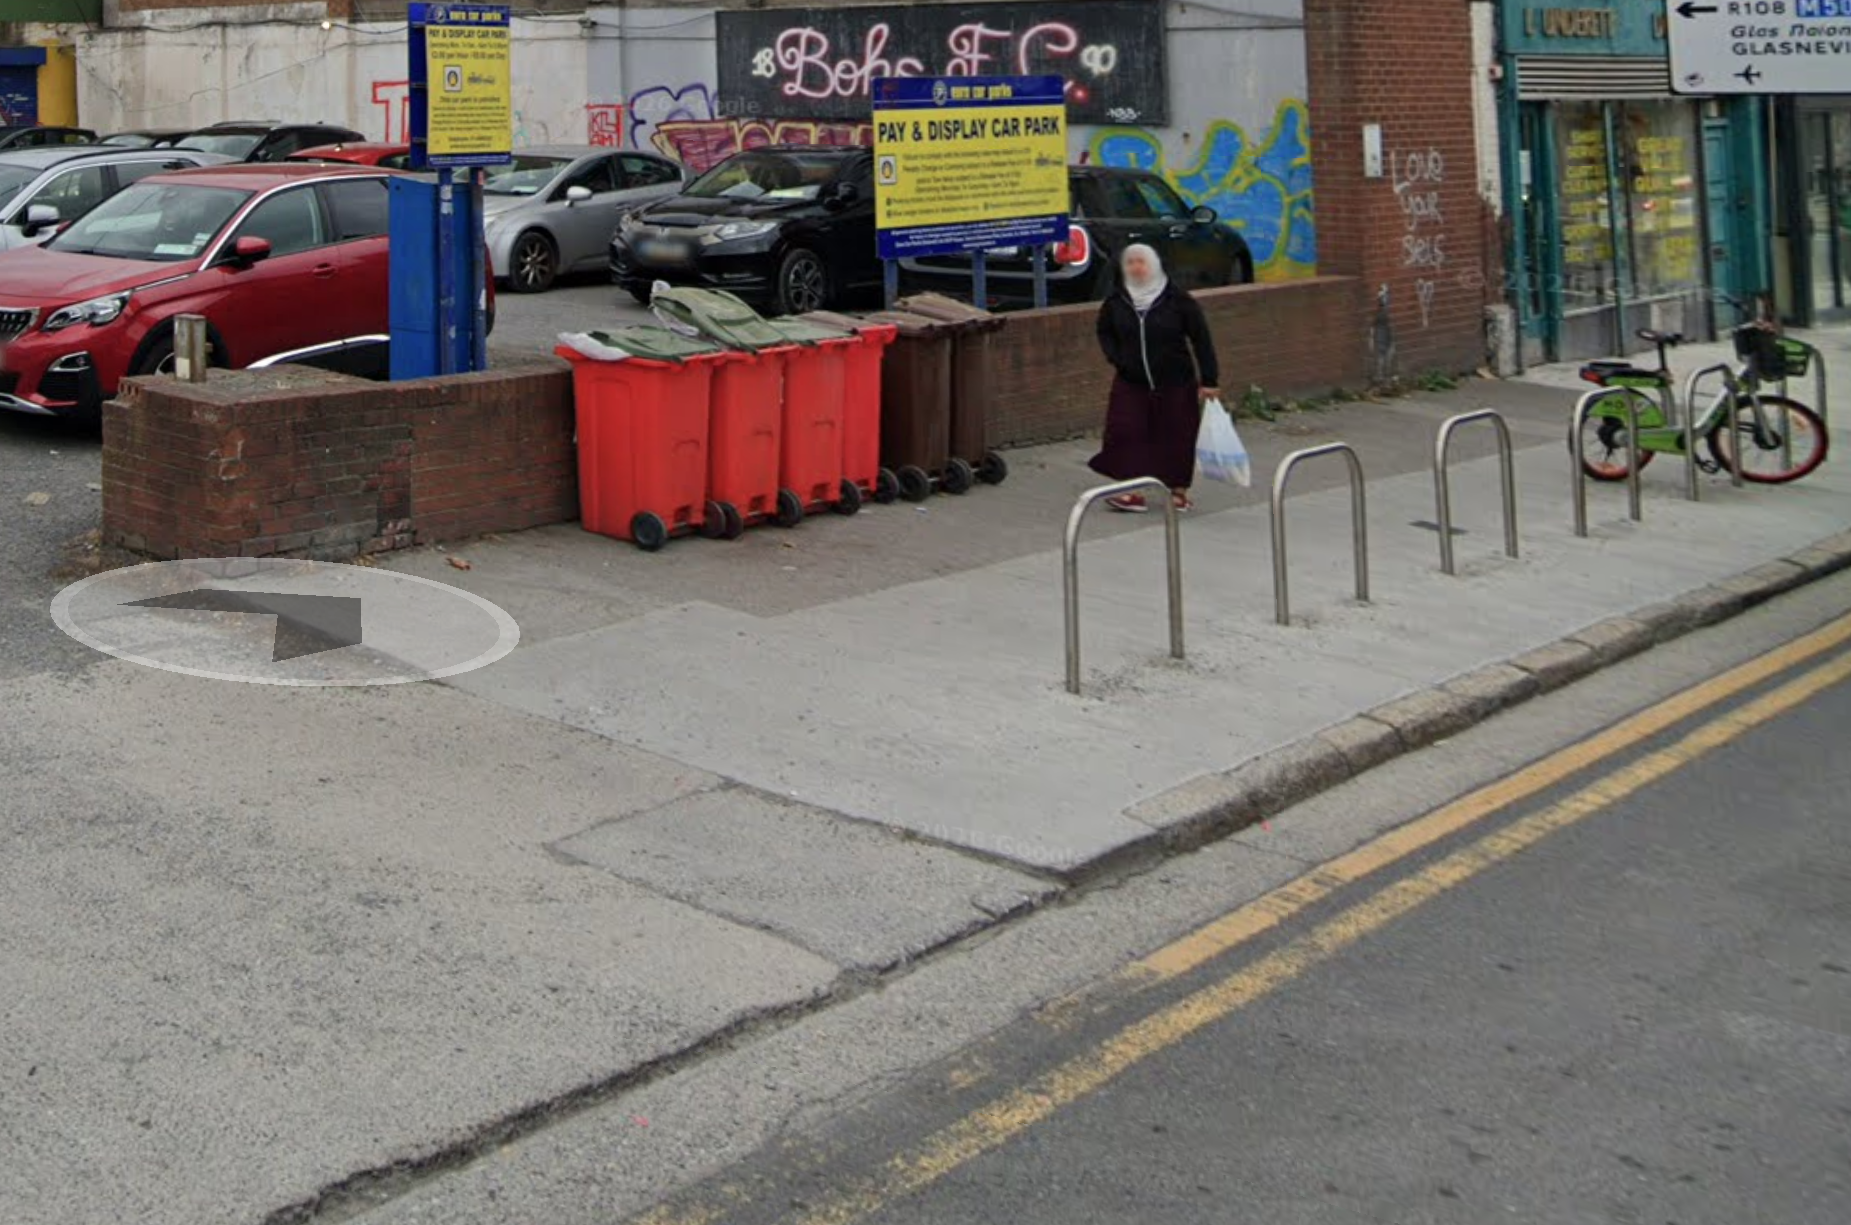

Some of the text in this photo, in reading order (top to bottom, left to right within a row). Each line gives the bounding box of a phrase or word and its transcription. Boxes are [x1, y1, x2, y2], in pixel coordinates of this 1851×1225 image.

[1728, 1, 1786, 16] R108
[1731, 25, 1778, 39] Glas
[1732, 40, 1851, 56] GLASNEVI
[878, 116, 1060, 143] PAY & DISPLAY CAR PARK
